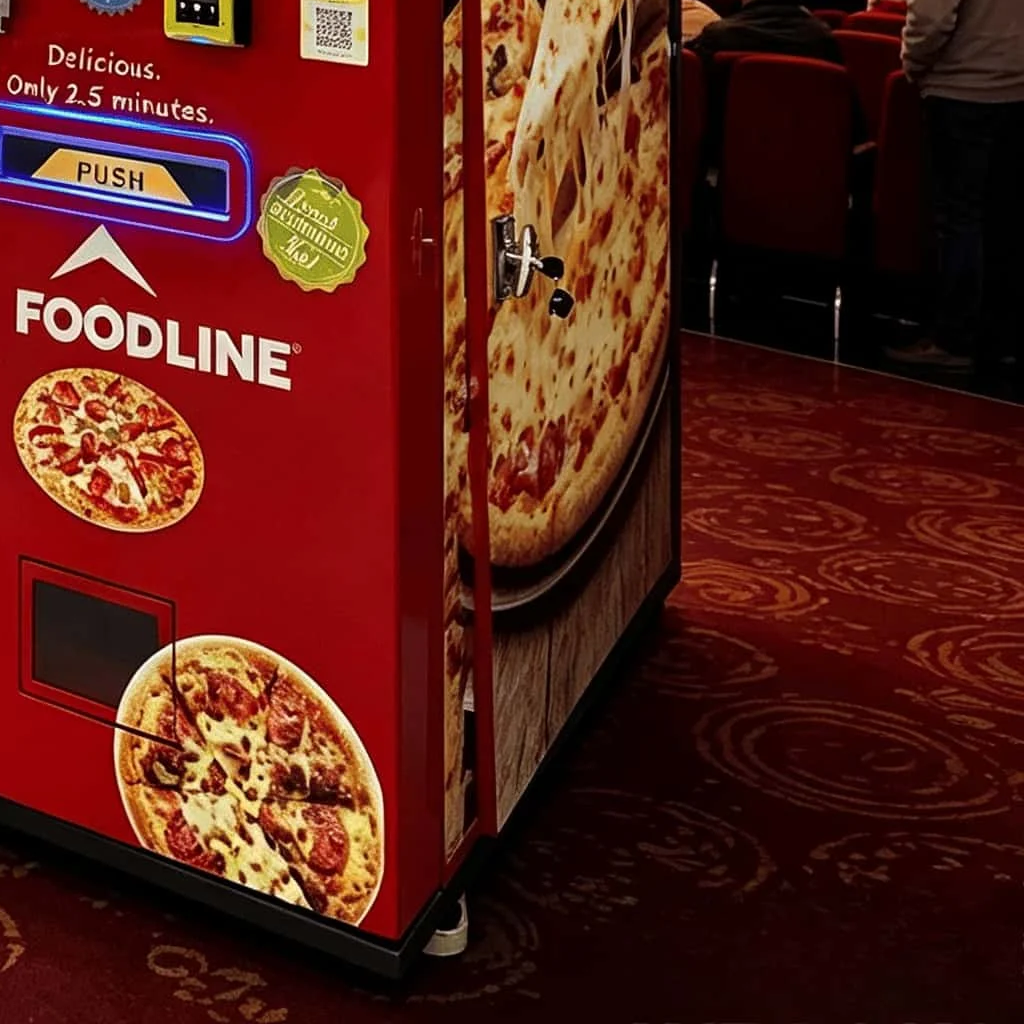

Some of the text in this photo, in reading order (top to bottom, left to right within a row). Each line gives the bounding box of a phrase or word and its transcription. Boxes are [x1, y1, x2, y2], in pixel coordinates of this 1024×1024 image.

[47, 43, 161, 81] Delicious.
[112, 91, 214, 125] minutes.
[77, 161, 144, 192] PUSH
[16, 288, 292, 391] FOODLINE
